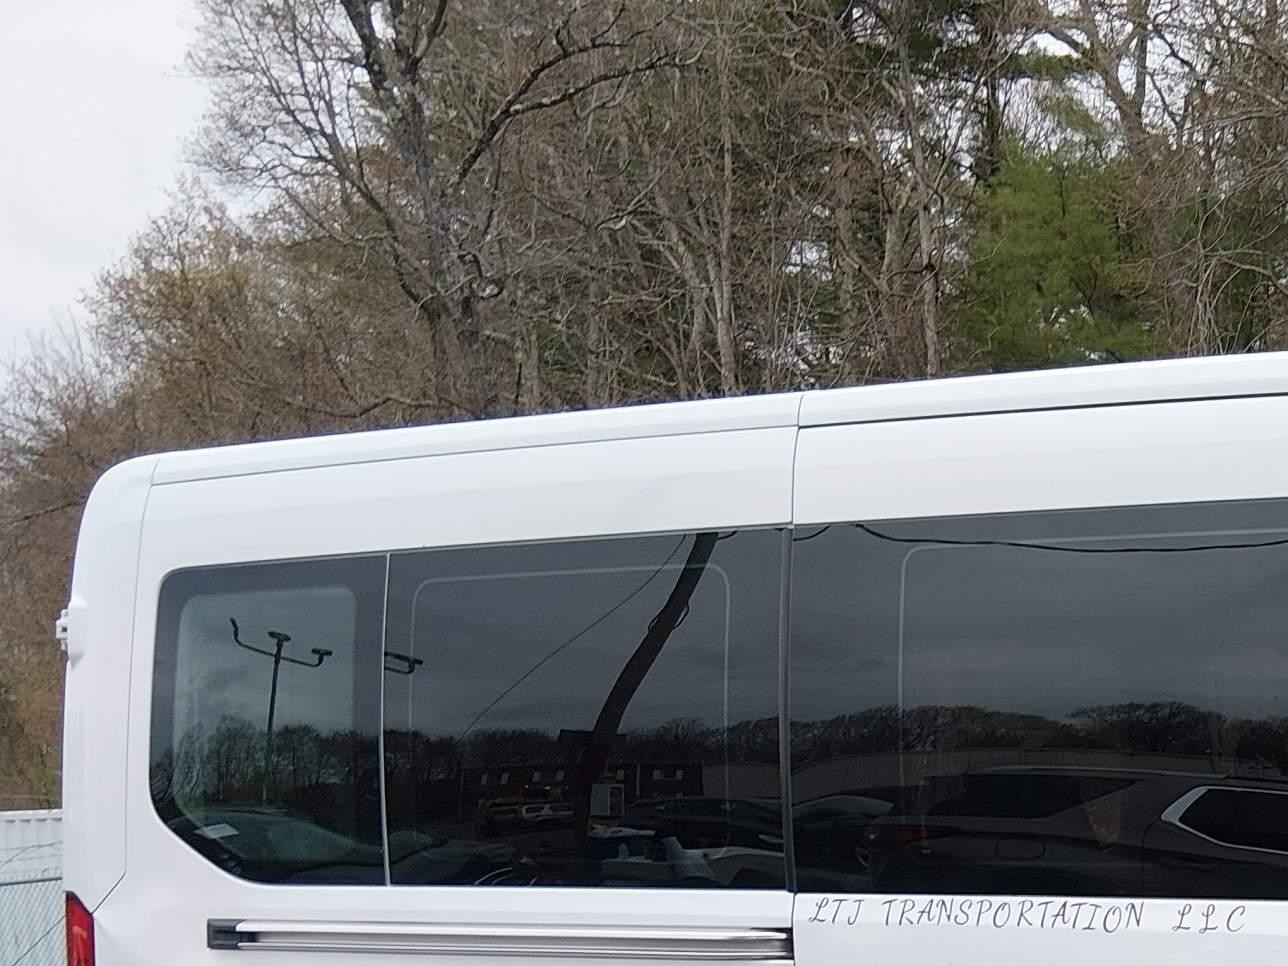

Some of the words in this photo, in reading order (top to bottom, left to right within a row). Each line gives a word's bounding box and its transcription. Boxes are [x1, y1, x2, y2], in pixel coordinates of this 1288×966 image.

[808, 899, 864, 925] LTJ
[881, 898, 1145, 934] TRANSPORTATION
[1171, 903, 1247, 933] LLC
